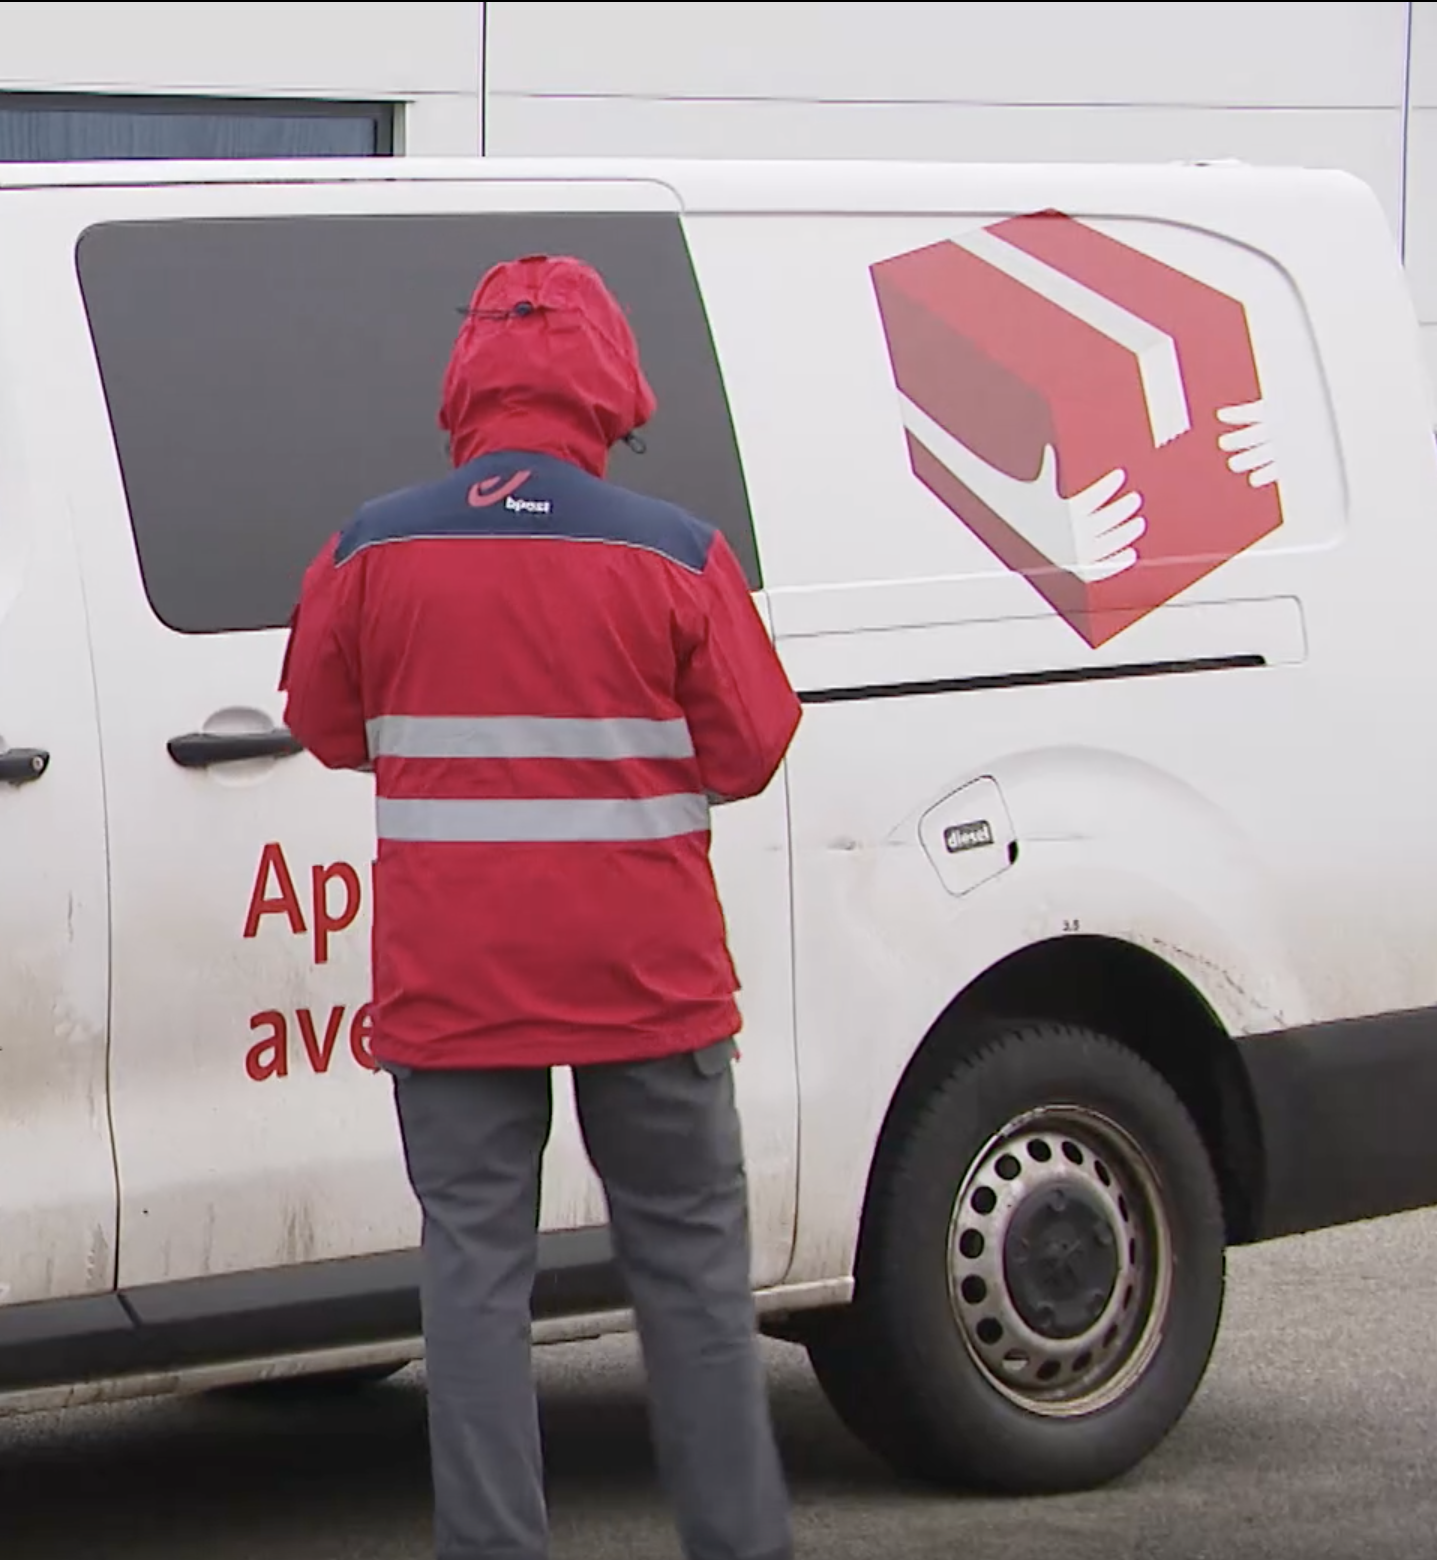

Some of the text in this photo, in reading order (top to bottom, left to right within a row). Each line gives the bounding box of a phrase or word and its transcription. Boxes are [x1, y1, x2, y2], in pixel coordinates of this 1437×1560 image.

[505, 495, 550, 513] bpost
[947, 823, 991, 849] diesel
[243, 841, 362, 964] Ap
[245, 1002, 381, 1082] ave
